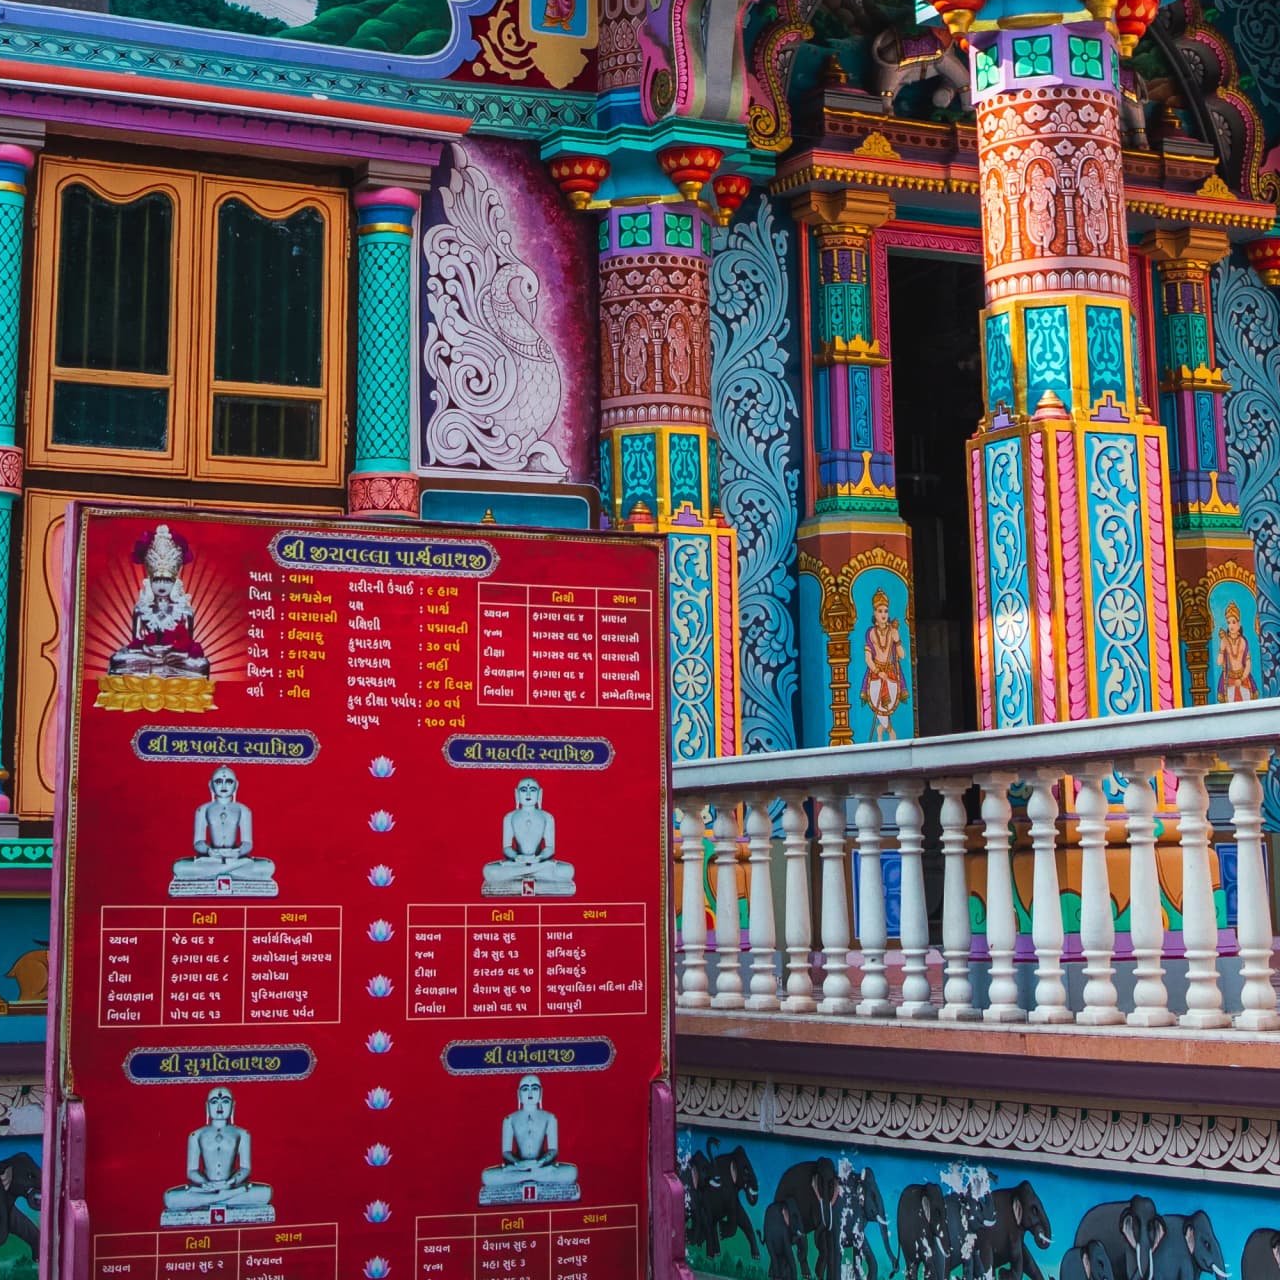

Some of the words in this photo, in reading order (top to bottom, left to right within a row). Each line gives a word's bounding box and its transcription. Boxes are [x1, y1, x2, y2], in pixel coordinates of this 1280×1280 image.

[282, 540, 305, 560] શ્રી
[310, 544, 390, 563] જીરાવલ્લા
[249, 572, 273, 583] માતા
[288, 575, 314, 585] વામા
[248, 586, 272, 601] પિતા
[348, 579, 385, 594] શરીરની
[426, 587, 434, 596] ૯
[437, 587, 459, 597] હાથ
[551, 591, 575, 603] તિથી
[612, 595, 637, 605] સ્થાન
[348, 601, 365, 612] યક્ષ
[247, 606, 276, 621] નગરી
[287, 610, 338, 623] વારાણસી
[483, 610, 510, 619] ચ્યવન
[532, 612, 561, 622] ફાગણ
[562, 614, 576, 622] વદ
[601, 615, 627, 624] પ્રાણત
[247, 624, 265, 639] વંશ
[483, 630, 503, 638] જન્મ
[532, 632, 565, 641] માગસર
[566, 633, 580, 641] વદ
[582, 633, 593, 642] ૧૦
[601, 632, 640, 644] વારાણસી
[247, 643, 269, 659] ગોત્ર
[348, 638, 392, 653] કુમારકાળ
[426, 642, 441, 652] ૩૦
[443, 640, 461, 653] વર્ષ
[483, 646, 505, 658] દીક્ષા
[532, 651, 565, 660] માગસર
[567, 652, 580, 660] વદ
[582, 653, 593, 661] ૧૧
[601, 652, 640, 662] વારાણસી
[347, 657, 391, 669] રાજ્યકાળ
[426, 658, 449, 672] નહીં
[286, 665, 305, 679] સર્પ
[483, 666, 525, 679] કેવળજ્ઞાન
[532, 670, 561, 680] ફાગણ
[562, 672, 576, 680] વદ
[578, 672, 585, 680] ૪
[601, 671, 640, 681] વારાણસી
[425, 681, 441, 690] ૮૪
[444, 677, 473, 691] દિવસ
[246, 682, 265, 698] વર્ણ
[286, 685, 311, 699] નીલ
[483, 685, 514, 697] નિર્વાણ
[532, 690, 561, 699] ફાગણ
[563, 691, 577, 702] સુદ
[347, 696, 363, 711] કુલ
[365, 692, 388, 707] દીક્ષા
[390, 693, 417, 708] પર્યાય
[425, 699, 441, 708] ૭૦
[443, 696, 461, 709] વર્ષ
[346, 715, 380, 730] આયુષ્ય
[424, 718, 446, 728] ૧૦૦
[448, 715, 466, 728] વર્ષ
[148, 735, 168, 752] શ્રી
[172, 736, 239, 754] ઋષભદેવ
[244, 738, 304, 756] સ્વામિજી
[464, 743, 482, 760] શ્રી
[486, 743, 534, 760] મહાવીર
[539, 745, 594, 762] સ્વામિજી
[192, 912, 218, 925] તિથી
[280, 913, 308, 922] સ્થાન
[491, 910, 515, 922] તિથી
[582, 911, 607, 919] સ્થાન
[108, 937, 138, 945] ચ્યવન
[171, 933, 188, 945] જેઠ
[190, 936, 205, 945] વદ
[207, 937, 215, 945] ૪
[415, 934, 442, 942] ચ્યવન
[502, 933, 517, 945] સુદ
[546, 932, 573, 940] પ્રાણત
[108, 955, 130, 964] જન્મ
[171, 955, 203, 965] ફાગણ
[205, 955, 220, 963] વદ
[222, 955, 229, 963] ૮
[251, 951, 299, 966] અયોધ્યાનું
[414, 952, 435, 960] જન્મ
[472, 948, 489, 959] ચૈત્ર
[490, 951, 505, 962] સુદ
[507, 951, 519, 959] ૧૩
[107, 971, 132, 984] દીક્ષા
[251, 969, 289, 981] અયોધ્યા
[414, 966, 437, 978] દીક્ષા
[472, 968, 505, 977] કારતક
[507, 968, 521, 976] વદ
[522, 968, 534, 976] ૧૦
[170, 974, 203, 984] ફાગણ
[205, 974, 220, 982] વદ
[222, 974, 229, 982] ૮
[414, 984, 458, 997] કેવળજ્ઞાન
[472, 983, 501, 995] વૈશાખ
[503, 986, 518, 998] સુદ
[519, 986, 532, 994] ૧૦
[598, 981, 626, 992] નદિના
[627, 980, 644, 991] તીરે
[107, 990, 154, 1003] કેવળજ્ઞાન
[170, 992, 189, 1002] મહા
[191, 992, 206, 1001] વદ
[208, 992, 221, 1001] ૧૧
[250, 1010, 289, 1018] અષ્ટાપદ
[292, 1005, 315, 1018] પર્વત
[414, 1002, 446, 1014] નિર્વાણ
[472, 1001, 498, 1013] આસો
[499, 1004, 513, 1012] વદ
[515, 1004, 527, 1012] ૧૫
[546, 999, 582, 1014] પાવાપુરી
[106, 1008, 141, 1021] નિર્વાણ
[170, 1008, 189, 1020] પોષ
[191, 1011, 206, 1020] વદ
[208, 1011, 221, 1020] ૧૩
[484, 1046, 503, 1064] શ્રી
[507, 1045, 575, 1063] ધર્મનાથજી
[160, 1054, 181, 1072] શ્રી
[184, 1053, 280, 1076] સુમતિનાથજી
[501, 1217, 525, 1231] તિથી
[582, 1214, 608, 1224] સ્થાન
[185, 1236, 211, 1250] તિથી
[274, 1233, 303, 1243] સ્થાન
[423, 1245, 451, 1254] ચ્યવન
[482, 1240, 511, 1252] વૈશાખ
[512, 1241, 528, 1253] સુદ
[165, 1262, 196, 1272] શ્રાવણ
[198, 1261, 214, 1273] સુદ
[216, 1260, 224, 1269] ૨
[482, 1261, 500, 1270] મહા
[502, 1260, 517, 1271] સુદ
[519, 1259, 526, 1268] ૩
[557, 1255, 588, 1267] રત્નપુર
[102, 1264, 131, 1273] ચ્યવન
[423, 1264, 443, 1272] જન્મ
